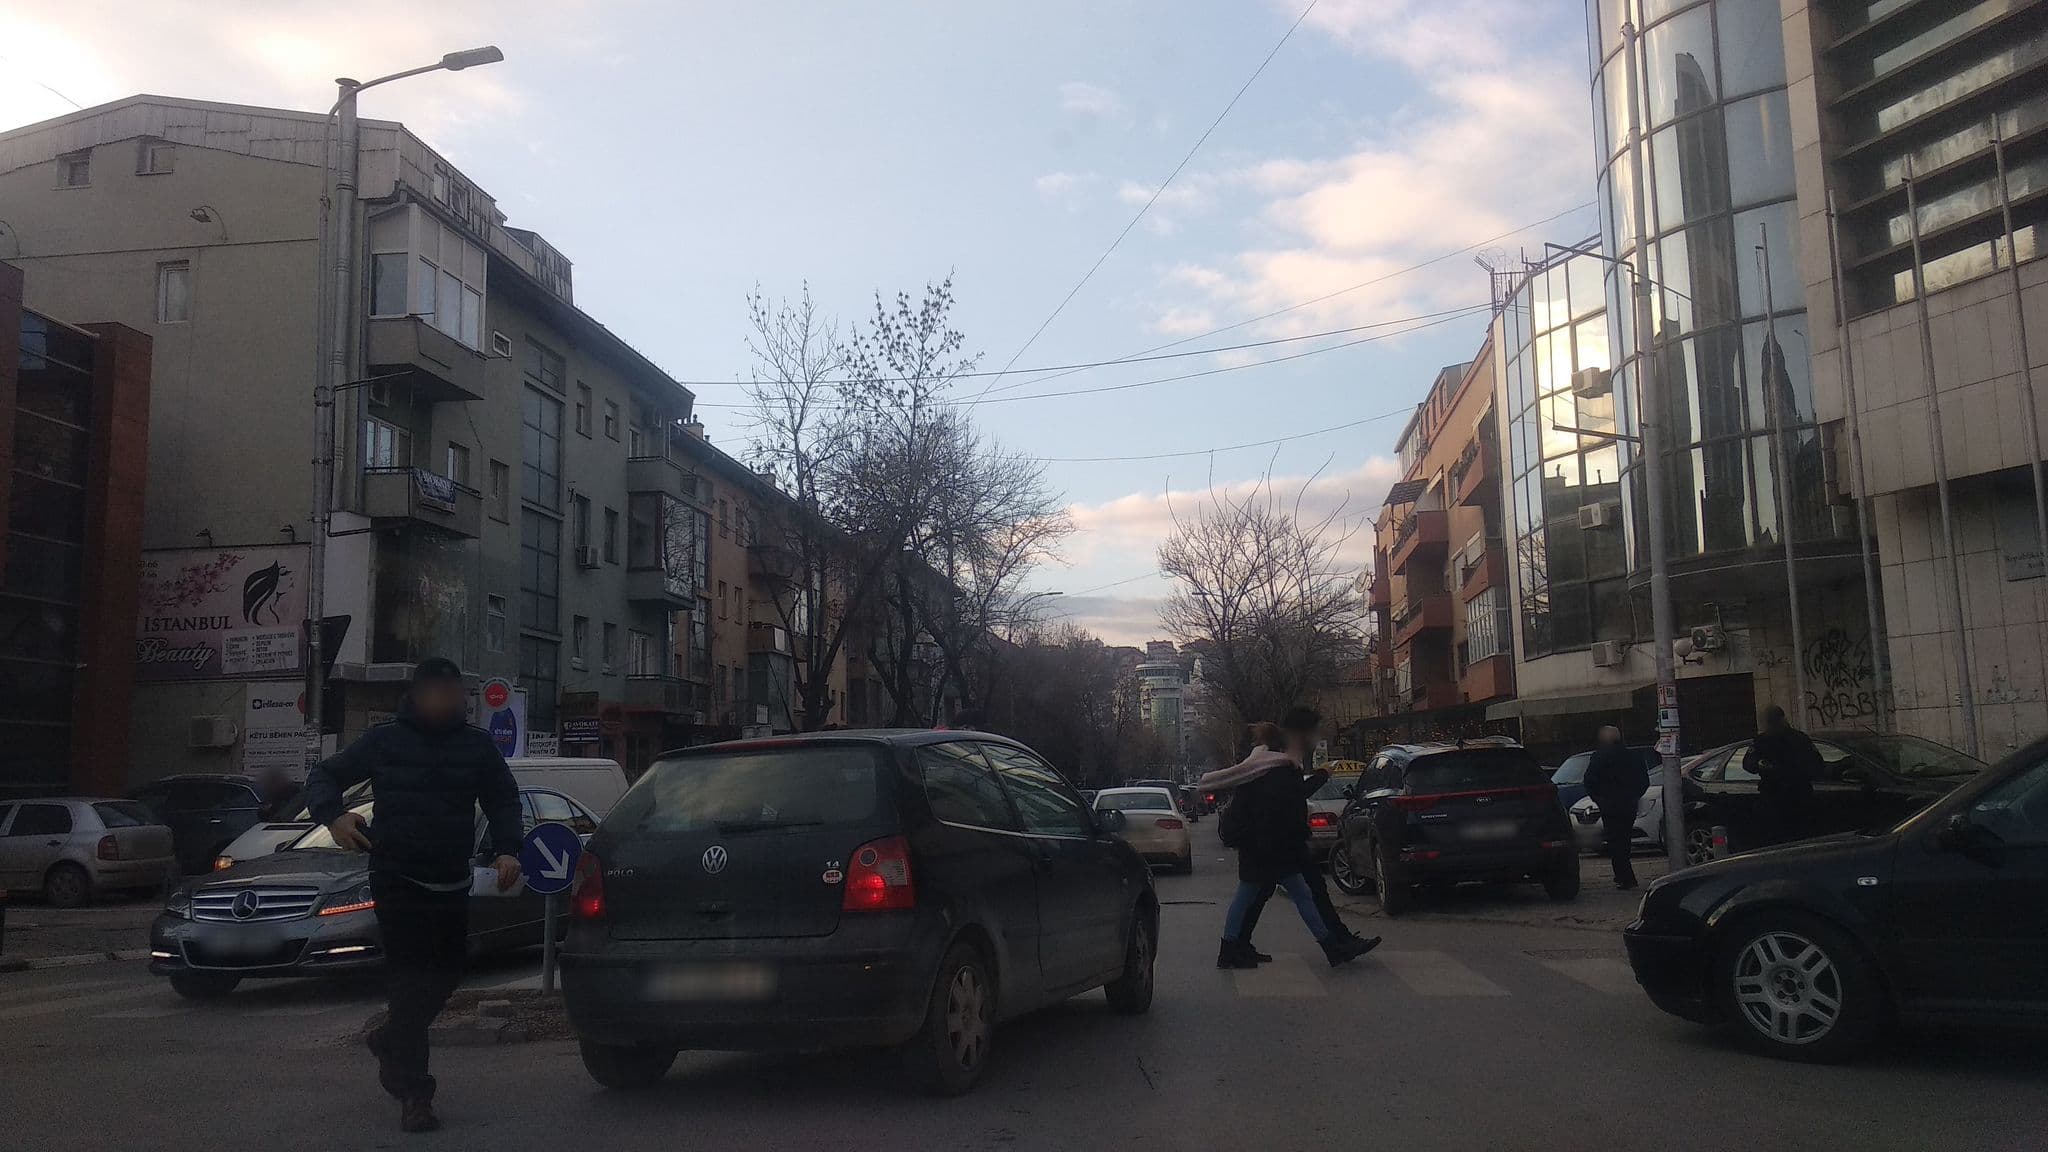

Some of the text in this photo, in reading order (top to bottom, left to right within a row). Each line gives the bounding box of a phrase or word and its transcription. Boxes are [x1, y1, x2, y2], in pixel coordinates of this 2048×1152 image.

[143, 615, 233, 632] ISTANBUL
[136, 637, 215, 672] Beauty
[607, 868, 633, 878] POLO
